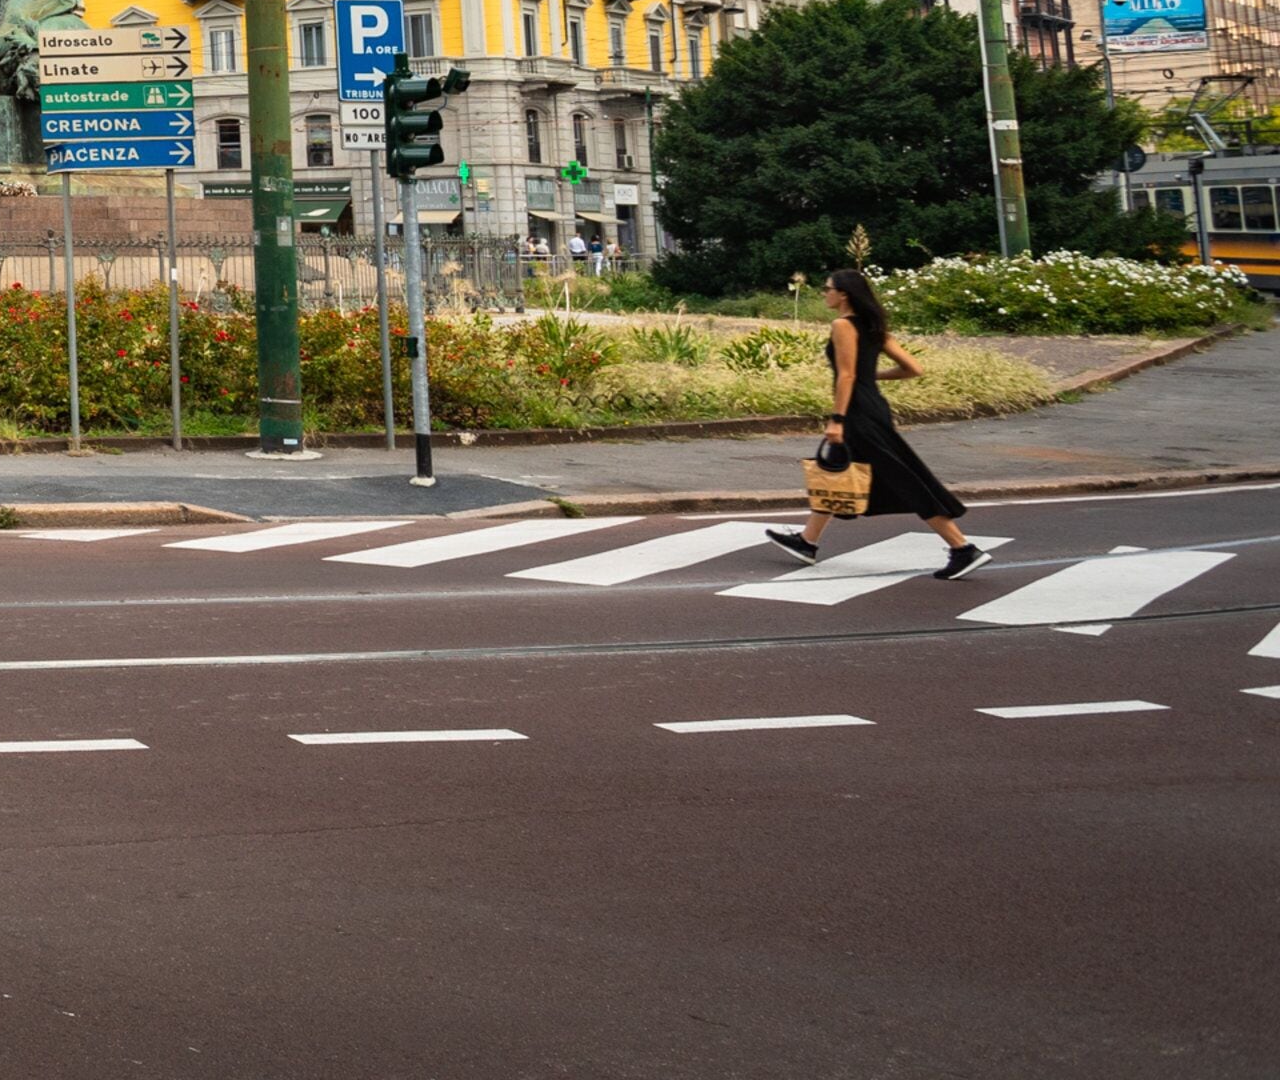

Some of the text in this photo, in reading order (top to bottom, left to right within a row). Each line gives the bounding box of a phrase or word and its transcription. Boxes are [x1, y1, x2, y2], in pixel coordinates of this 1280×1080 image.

[350, 5, 389, 55] P
[42, 36, 113, 48] Idroscalo
[366, 46, 398, 54] A ORE
[44, 64, 99, 76] Linate
[45, 91, 129, 103] autostrade
[345, 90, 384, 98] TRIBUN
[352, 108, 380, 120] 100
[45, 118, 142, 133] CREMONA
[345, 132, 359, 143] NO
[49, 147, 140, 166] PIACENZA
